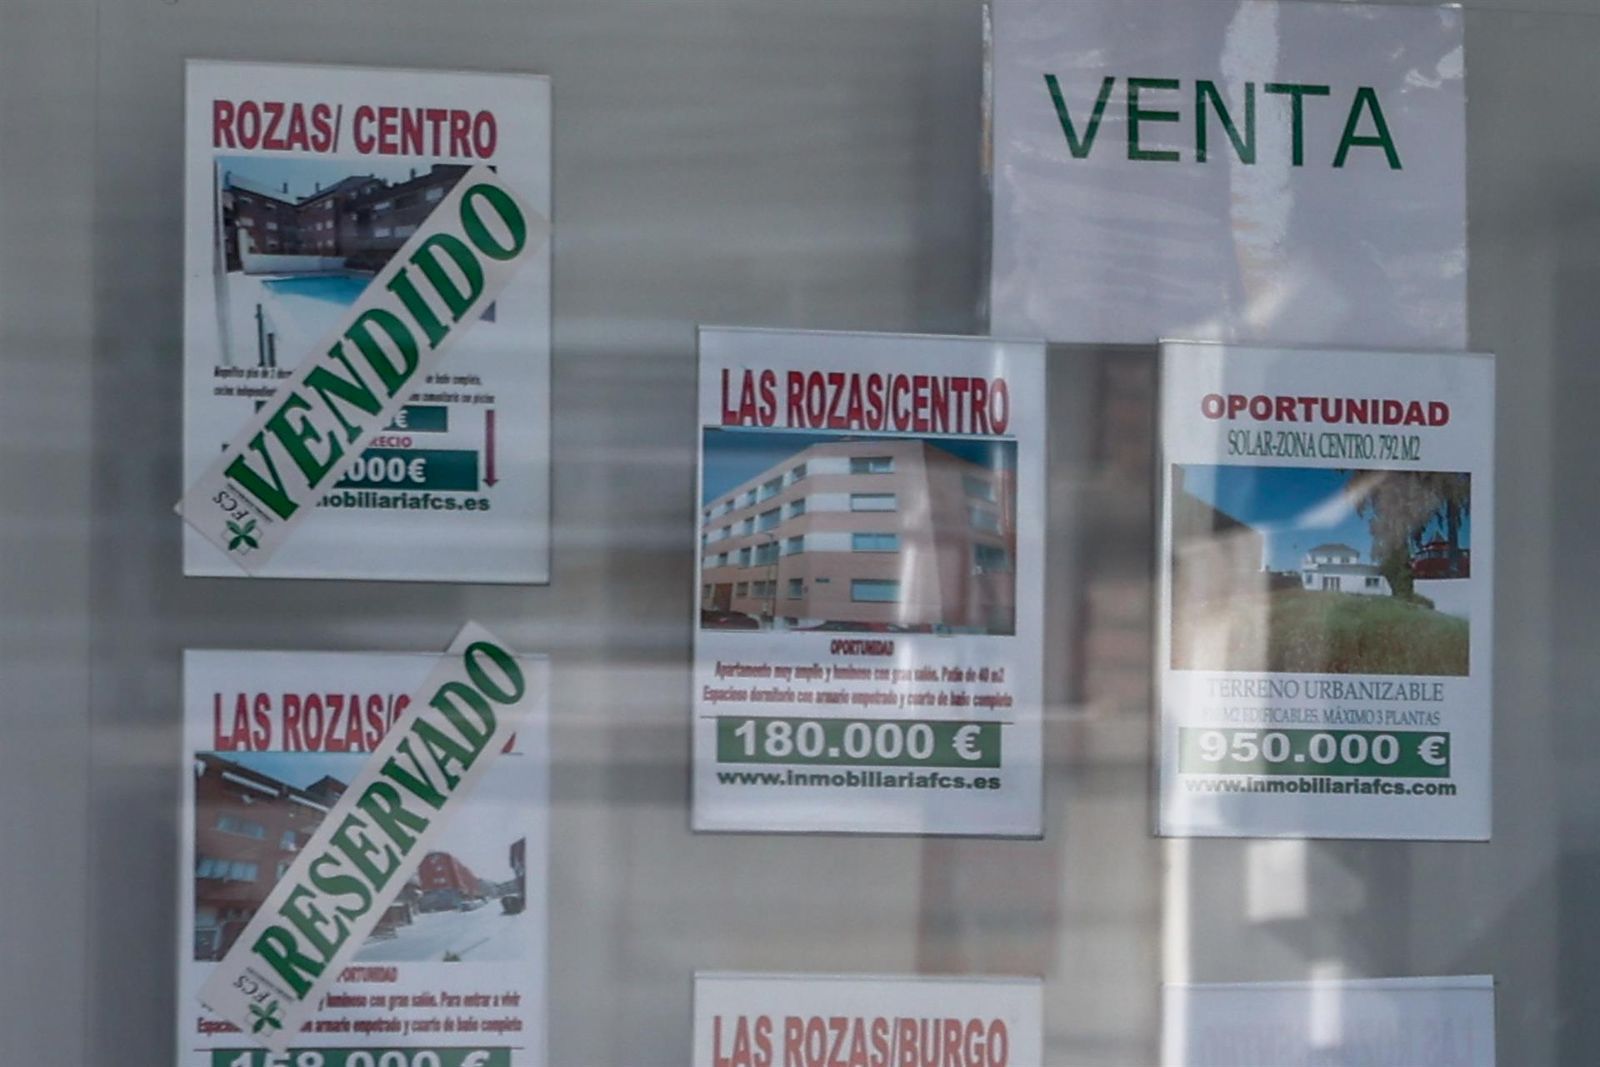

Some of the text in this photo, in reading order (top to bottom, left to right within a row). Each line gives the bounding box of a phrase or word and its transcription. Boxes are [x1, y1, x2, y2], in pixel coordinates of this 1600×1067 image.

[213, 99, 498, 159] ROZAS/ CENTRO
[1043, 73, 1403, 170] VENTA
[223, 182, 527, 521] VENDIDO
[721, 367, 1011, 436] LAS ROZAS/CENTRO
[1201, 393, 1450, 427] OPORTUNIDAD
[1227, 429, 1316, 459] SOLAR-ZONA
[1379, 434, 1400, 461] 792
[1401, 435, 1421, 462] M2
[212, 490, 249, 521] FCS
[1206, 679, 1445, 702] TERRENO URBANIZABLE
[214, 692, 412, 752] LAS ROZAS/
[1323, 705, 1375, 725] MÁXIMO
[1377, 710, 1383, 725] 3
[1385, 710, 1441, 726] PLANTAS
[734, 720, 983, 762] 180.000 €
[1199, 731, 1447, 766] 950.000 €
[717, 769, 1002, 790] www.inmobiliariafcs.es
[1185, 776, 1457, 796] www.inmobiliariafcs.com
[251, 640, 526, 1001] RESERVADO
[713, 1015, 1009, 1067] LAS ROZAS/BURGO
